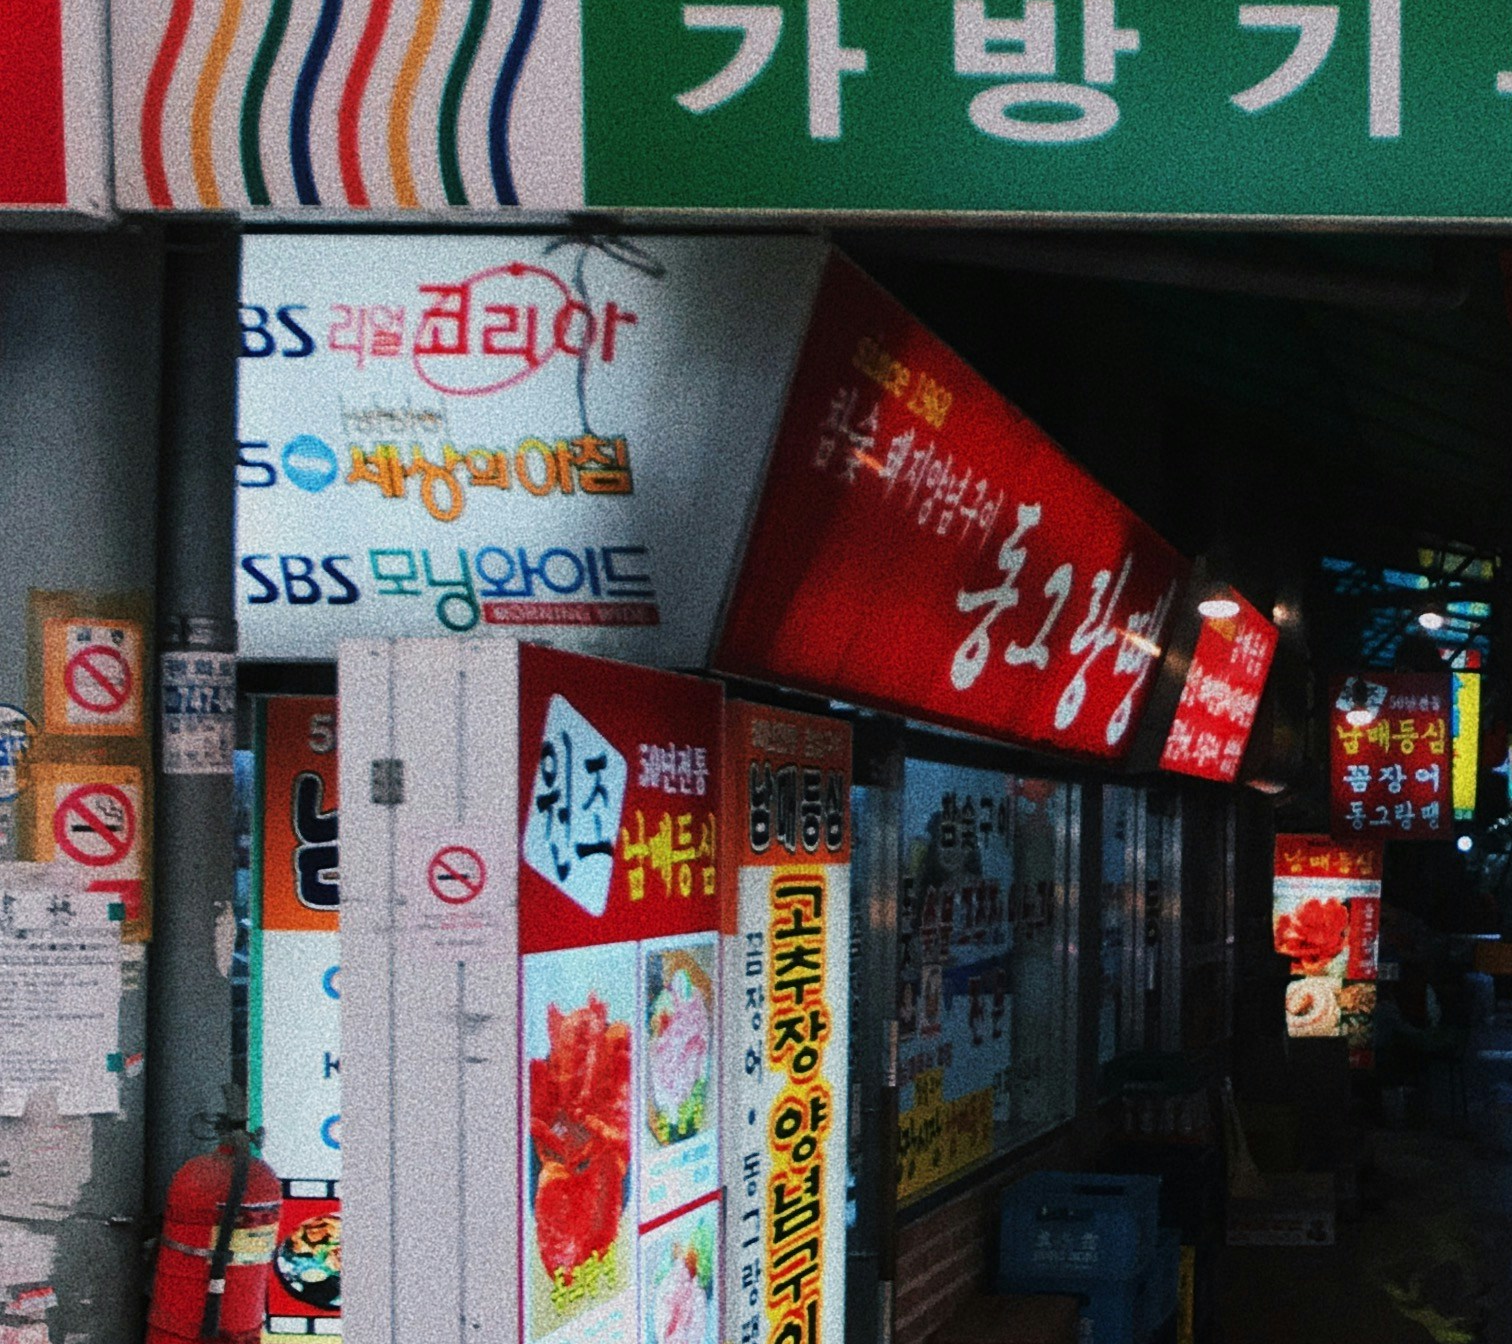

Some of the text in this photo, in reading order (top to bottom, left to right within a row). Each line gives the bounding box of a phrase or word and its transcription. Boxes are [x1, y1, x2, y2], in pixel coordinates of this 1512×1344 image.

[239, 305, 316, 358] BS
[241, 555, 362, 605] SBS
[950, 502, 1175, 746] 동그랑땡
[1337, 718, 1447, 755] 남매등심
[1343, 764, 1441, 794] 꼼장어
[536, 730, 614, 883] 원조
[1344, 801, 1441, 830] 동그랑땡
[622, 810, 716, 900] 남매등심
